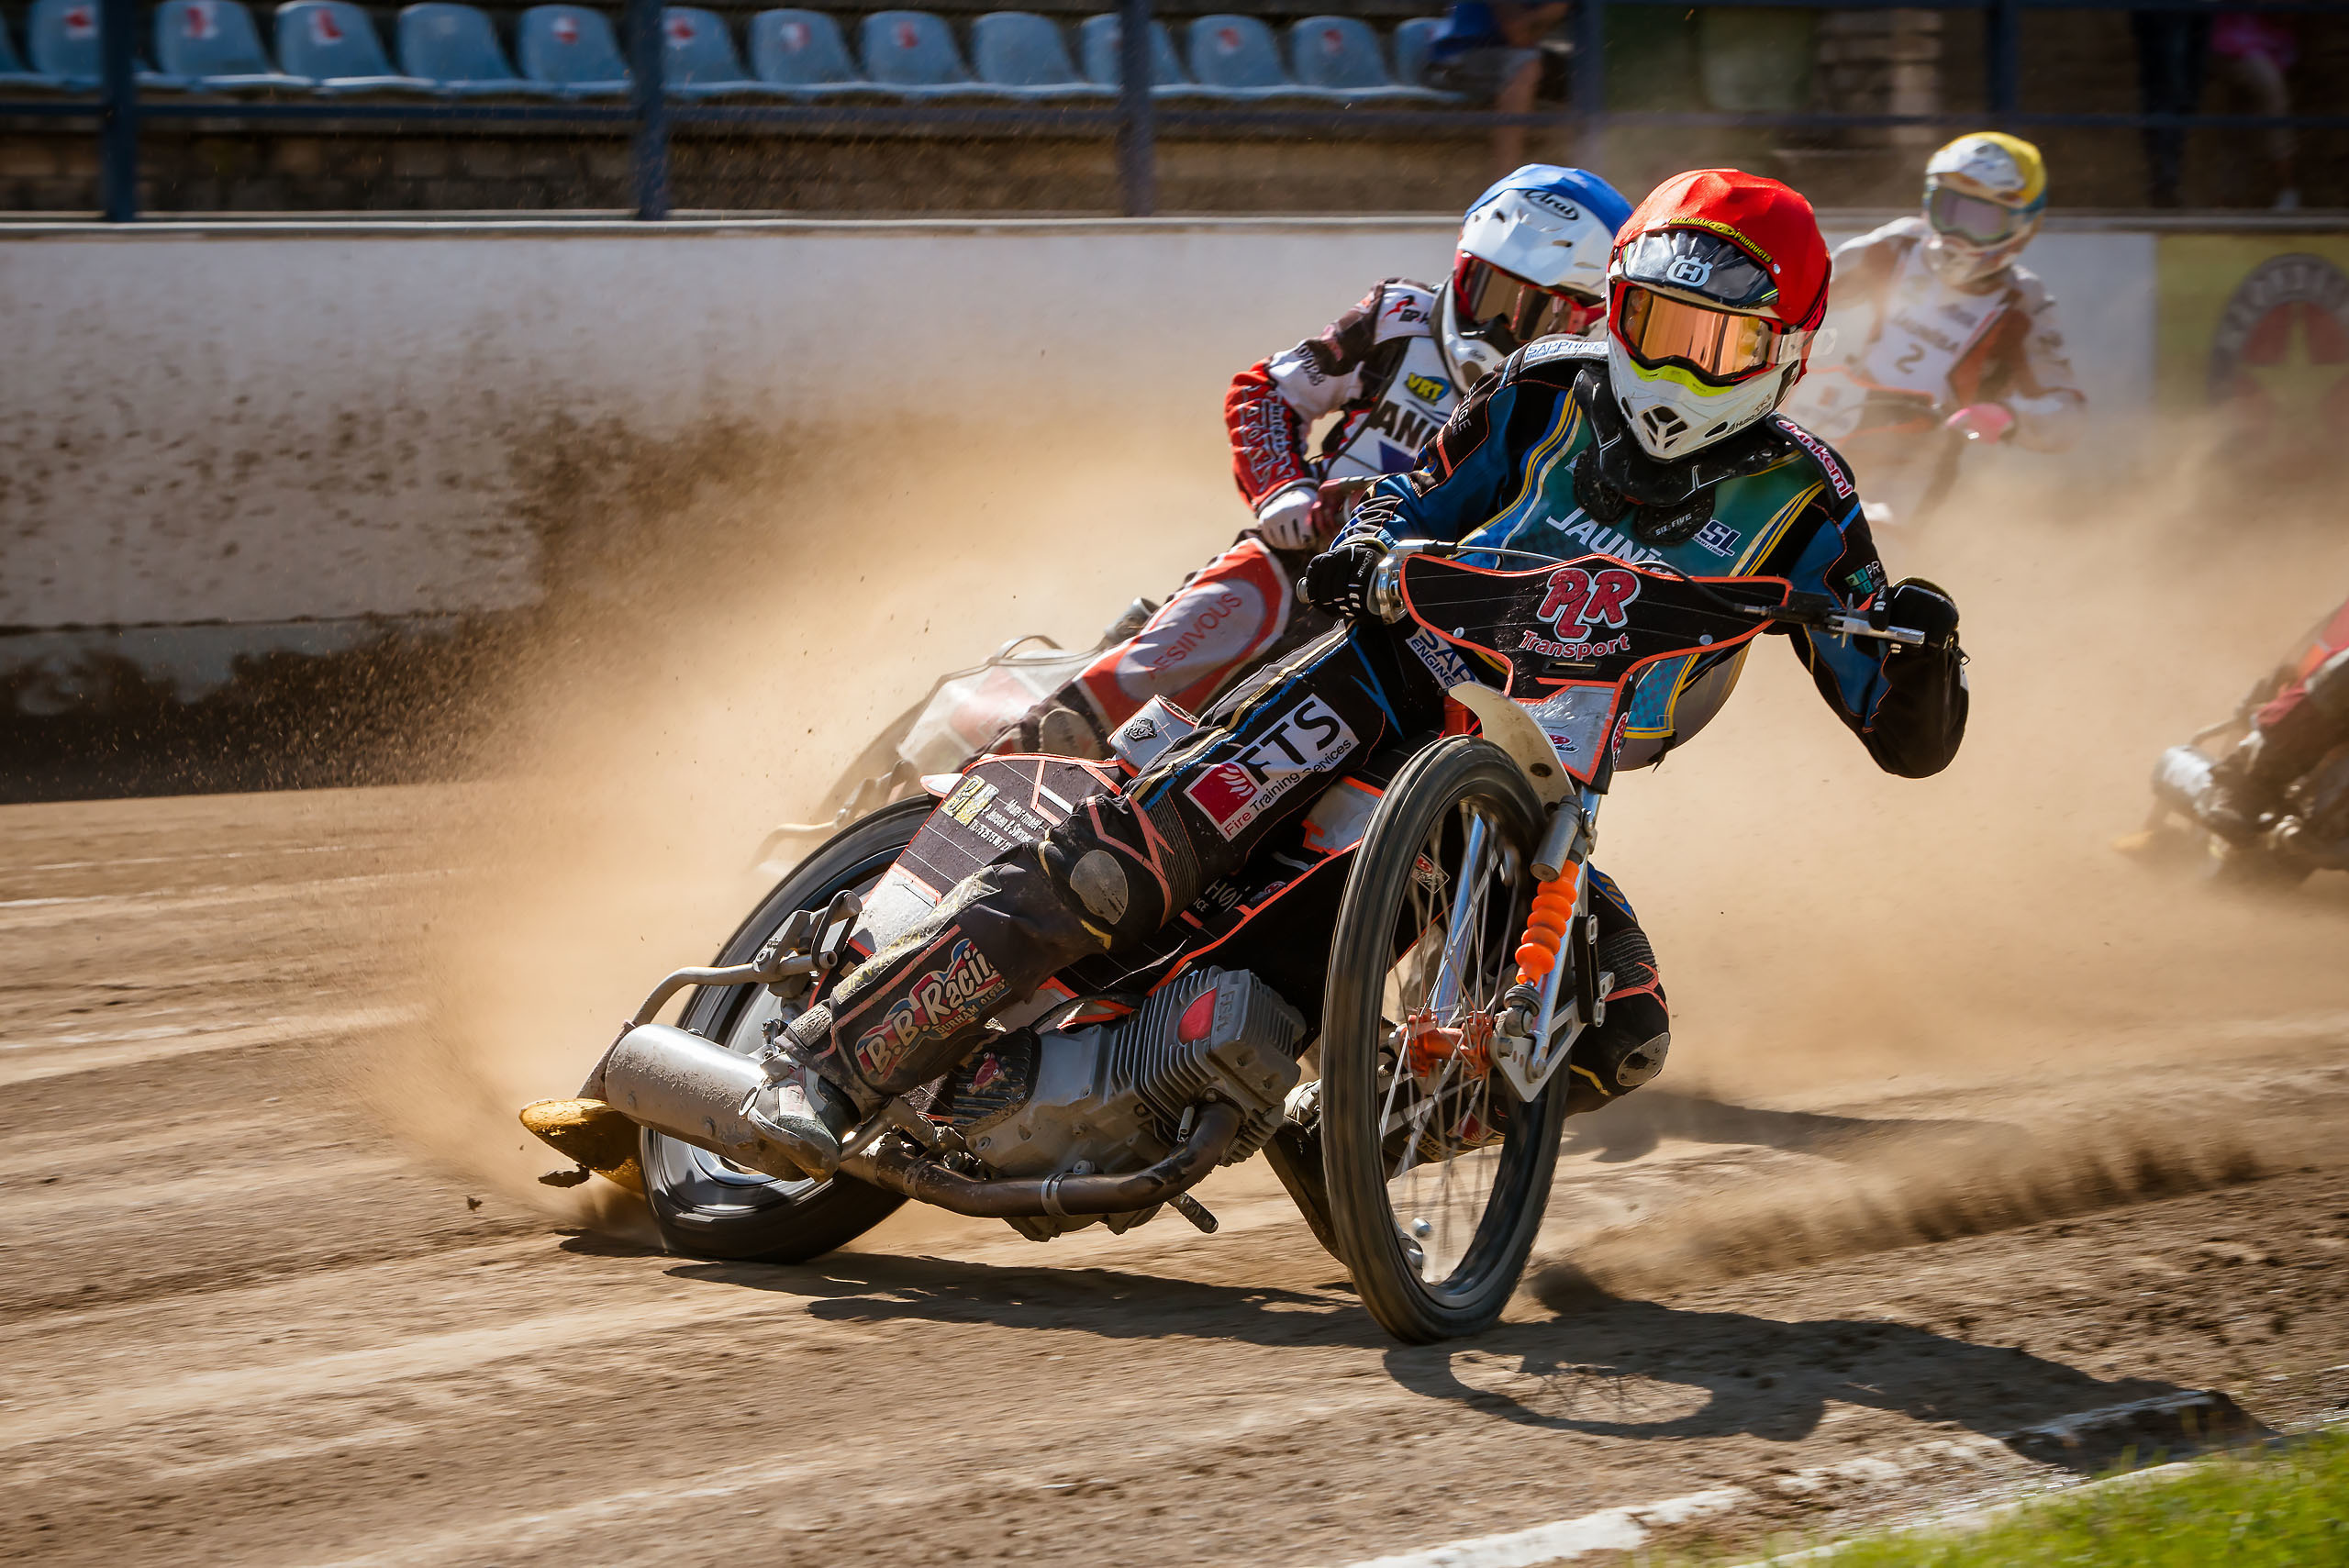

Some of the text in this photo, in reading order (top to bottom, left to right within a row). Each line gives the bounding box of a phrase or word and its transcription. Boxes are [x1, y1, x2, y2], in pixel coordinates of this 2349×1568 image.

[1895, 342, 1926, 375] 2
[1537, 568, 1641, 642] PLR
[1410, 639, 1458, 688] ENGINE
[1519, 630, 1631, 661] Transport
[1234, 700, 1341, 786] FTS
[1224, 810, 1252, 837] Fire
[1250, 771, 1301, 813] Training
[934, 1004, 980, 1034] DURHAM
